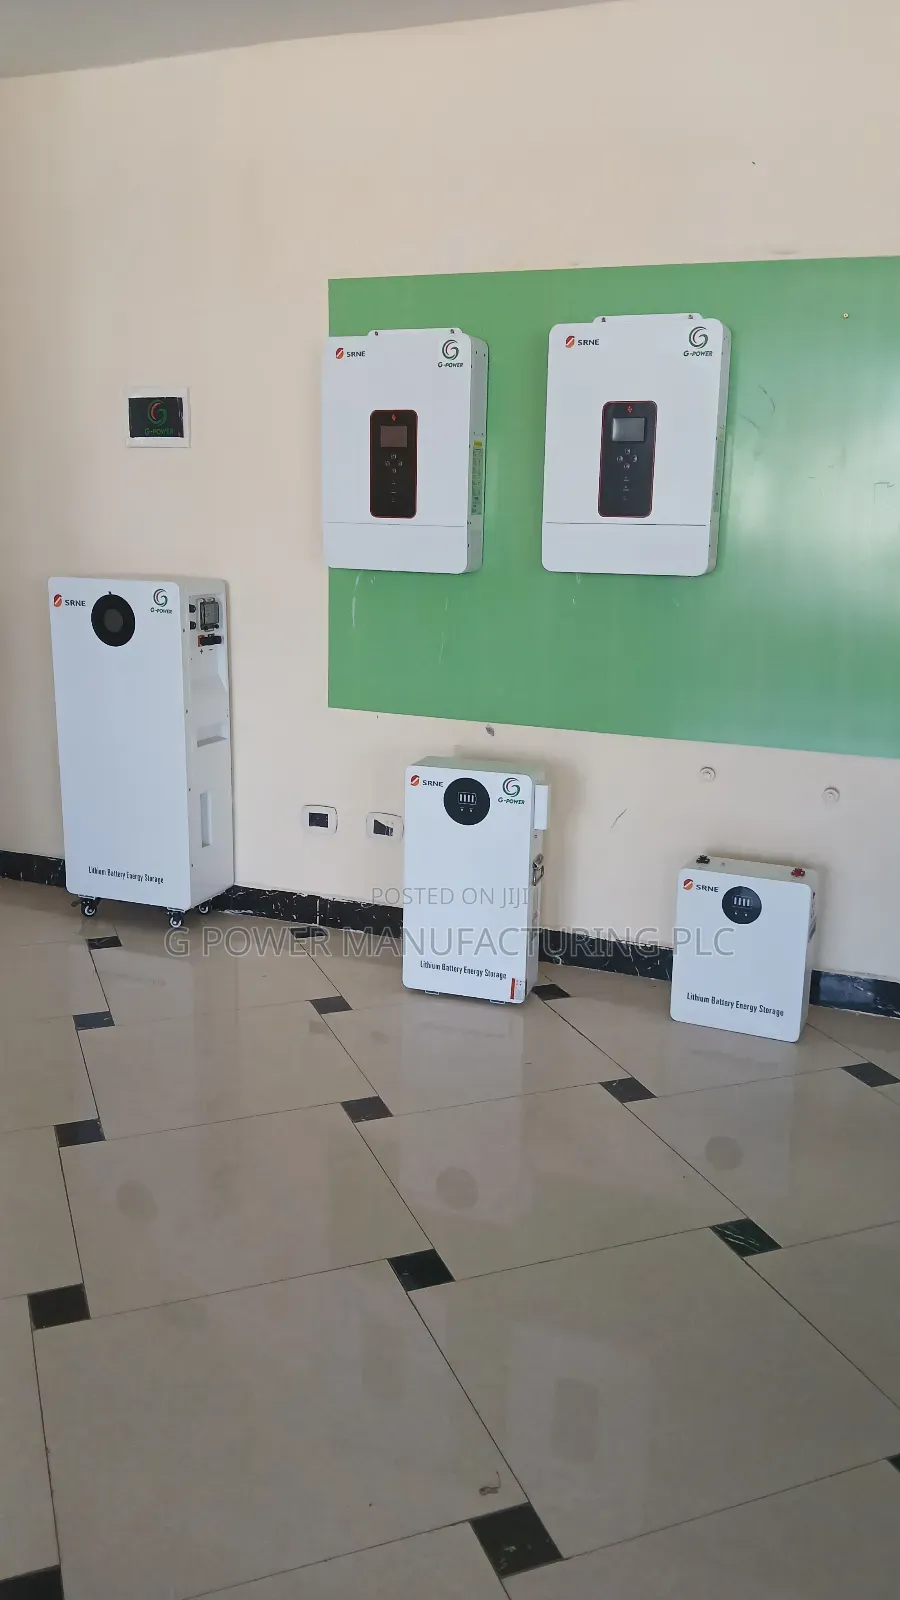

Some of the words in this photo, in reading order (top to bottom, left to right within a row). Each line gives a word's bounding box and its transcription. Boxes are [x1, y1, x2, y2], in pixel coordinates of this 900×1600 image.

[578, 338, 600, 346] SRNE
[346, 350, 366, 358] SRNE
[65, 599, 86, 607] SRNE
[422, 779, 444, 788] SRNE
[497, 797, 525, 805] G-POWER
[88, 865, 107, 876] Lithium
[107, 868, 126, 880] Battery
[126, 871, 143, 883] Energy
[144, 873, 164, 884] Storage
[695, 884, 719, 893] SRNE
[420, 960, 441, 970] Lithium
[441, 963, 463, 975] Battery
[463, 966, 484, 977] Energy
[484, 968, 507, 980] Storage
[686, 992, 710, 1003] Lithium
[711, 996, 735, 1009] Battery
[735, 1000, 758, 1013] Energy
[759, 1004, 784, 1018] Storage
